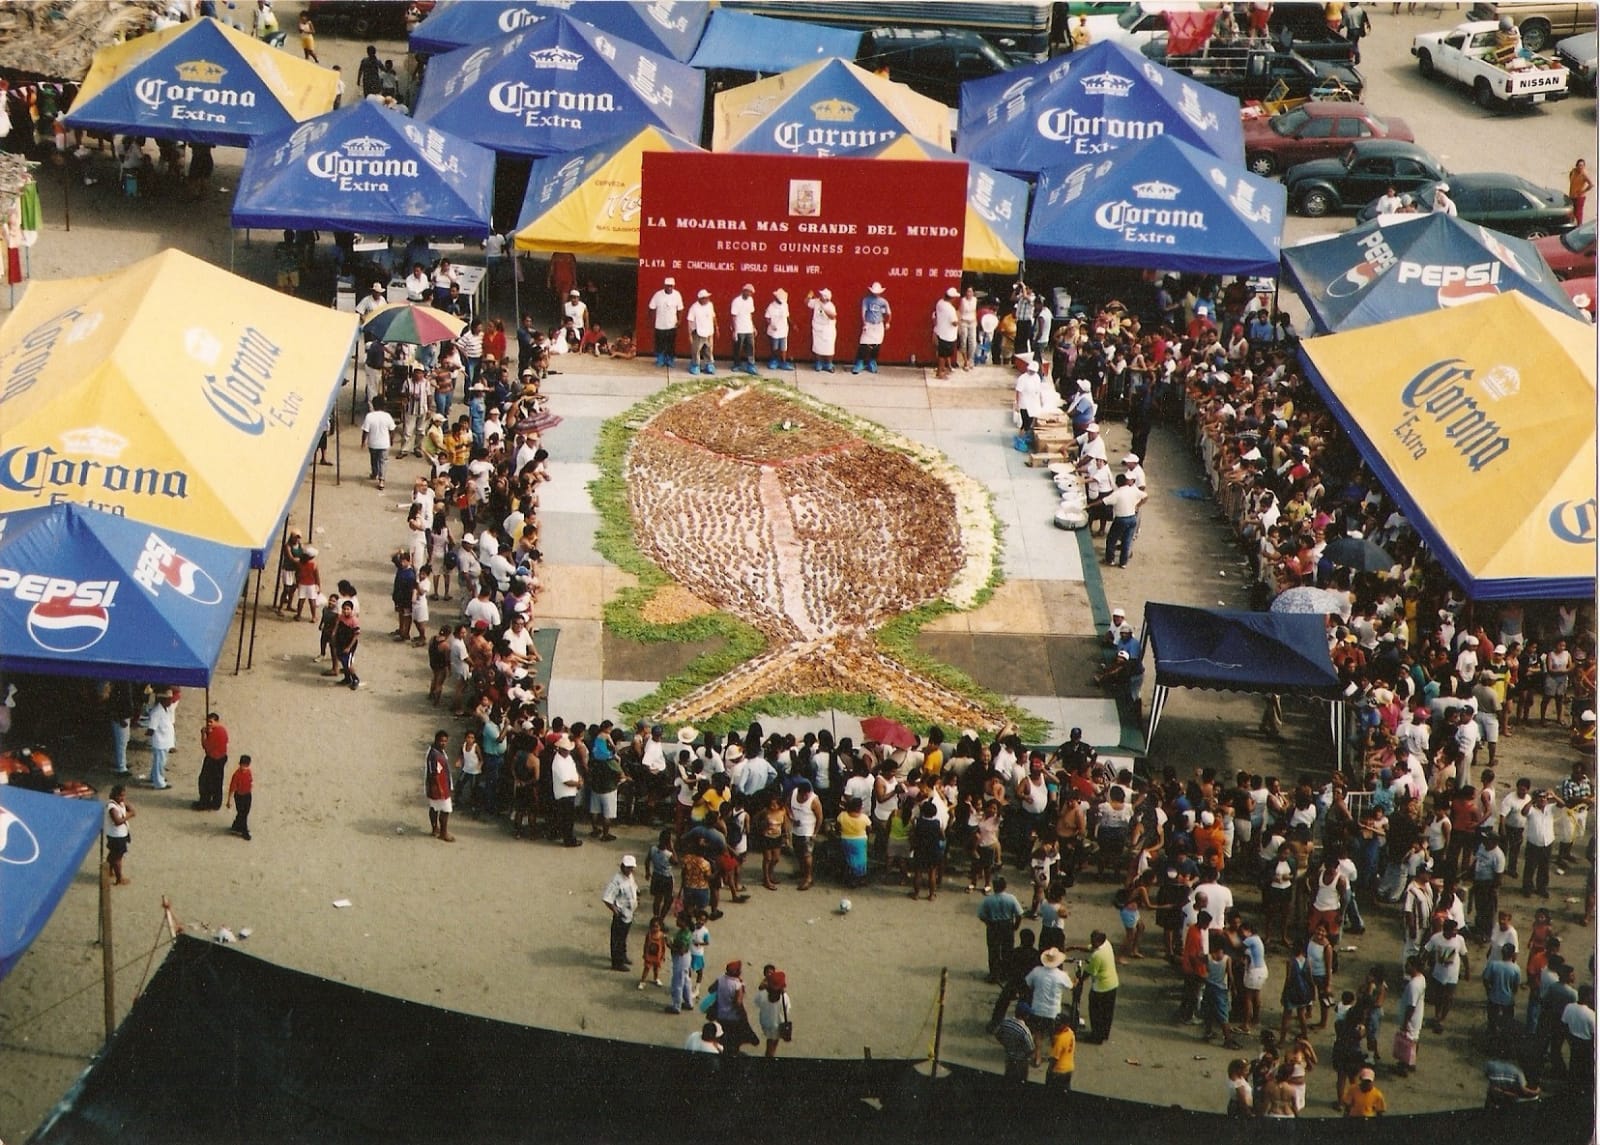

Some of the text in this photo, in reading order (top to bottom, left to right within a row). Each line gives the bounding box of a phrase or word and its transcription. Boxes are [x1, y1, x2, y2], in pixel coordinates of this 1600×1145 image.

[1520, 77, 1559, 88] NISSAN
[135, 78, 255, 109] Corona
[488, 81, 615, 116] Corona
[171, 105, 226, 123] Extra
[525, 111, 582, 129] Extra
[1074, 138, 1119, 154] Ext
[307, 150, 419, 182] Corona
[340, 177, 389, 192] Extra
[647, 216, 959, 237] LA MOJARRA MAS GRANDE DEL MUNDO
[1095, 200, 1205, 232] Corona
[1125, 227, 1175, 244] Extra
[717, 240, 889, 255] RECORD GUINNESS 2003
[639, 259, 665, 267] PLAYA
[672, 260, 682, 269] DE
[741, 263, 768, 272] URSULO
[773, 264, 799, 273] GALVAN
[806, 265, 823, 274] VER.
[888, 267, 908, 276] JULIO
[928, 268, 938, 277] DE
[1398, 260, 1500, 286] PEPSI
[1402, 358, 1510, 472] Corona
[1393, 415, 1427, 461] Extra
[0, 446, 188, 498] Corona
[133, 532, 177, 597] PEPSI
